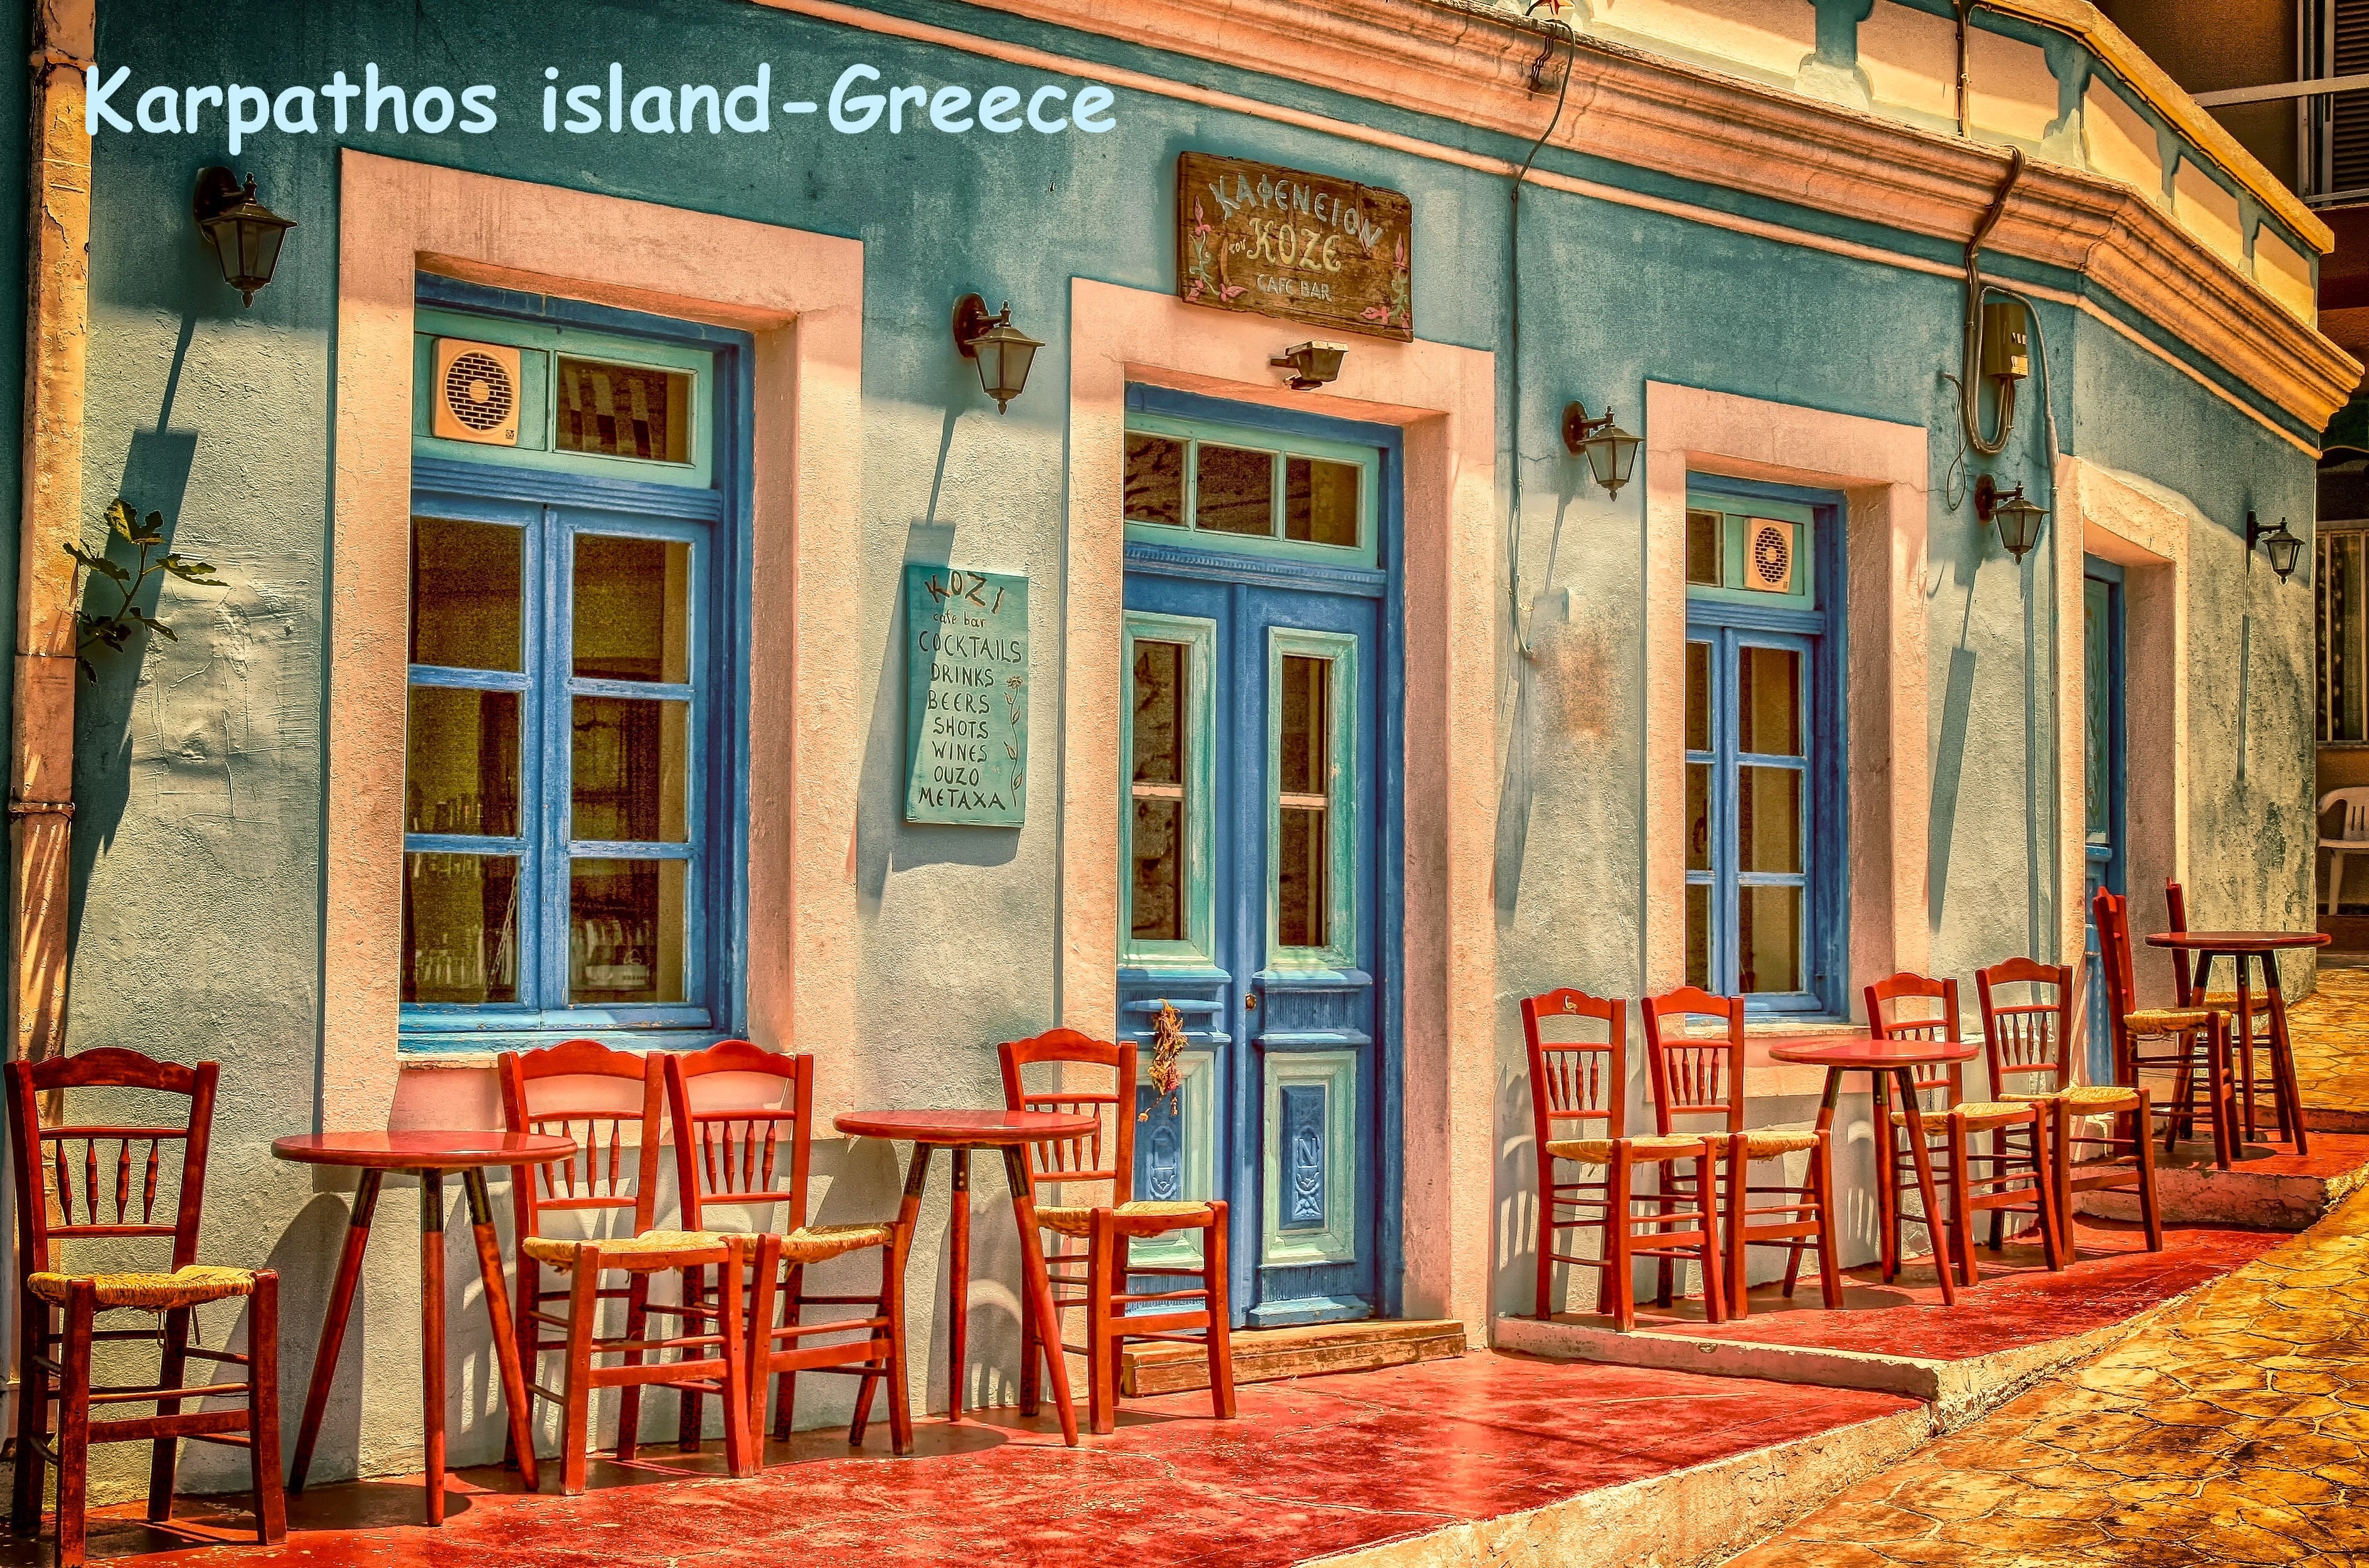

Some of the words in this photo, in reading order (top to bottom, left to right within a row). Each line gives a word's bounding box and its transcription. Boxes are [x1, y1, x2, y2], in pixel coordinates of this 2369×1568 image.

[1257, 273, 1294, 295] CAFE
[1301, 280, 1333, 302] BAR
[924, 570, 1005, 615] KOZI
[933, 610, 958, 625] cafe
[964, 611, 986, 628] bar
[918, 630, 1023, 664] COCKTAILS
[930, 662, 995, 688] DRINKS
[927, 689, 991, 715] BEERS
[932, 715, 990, 739] SHOTS
[931, 740, 988, 763] WINES
[934, 765, 980, 787] OUZO
[918, 787, 1007, 811] METAXA
